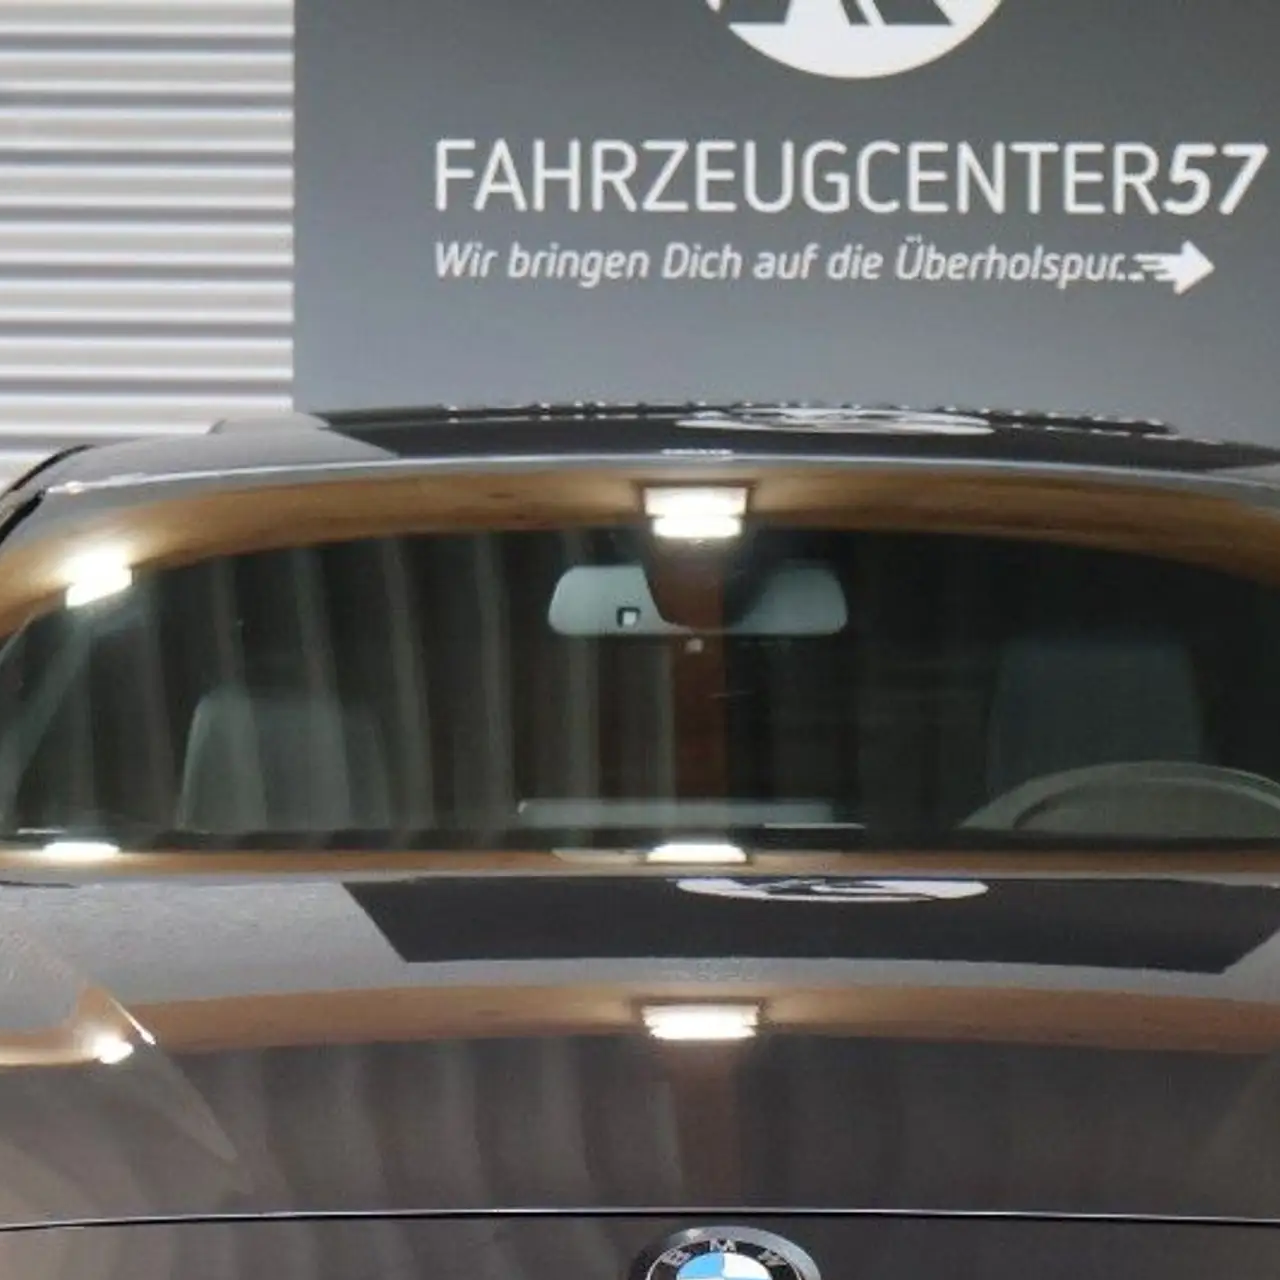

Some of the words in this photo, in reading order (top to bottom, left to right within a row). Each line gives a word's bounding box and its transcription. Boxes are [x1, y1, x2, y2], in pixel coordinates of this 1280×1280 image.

[435, 139, 1269, 215] FAHRZEUGCENTER57
[435, 241, 498, 278] Wir
[507, 241, 650, 289] bringen
[661, 242, 743, 279] Dich
[753, 243, 819, 280] auf
[827, 243, 884, 280] die
[661, 1238, 787, 1266] BMW
